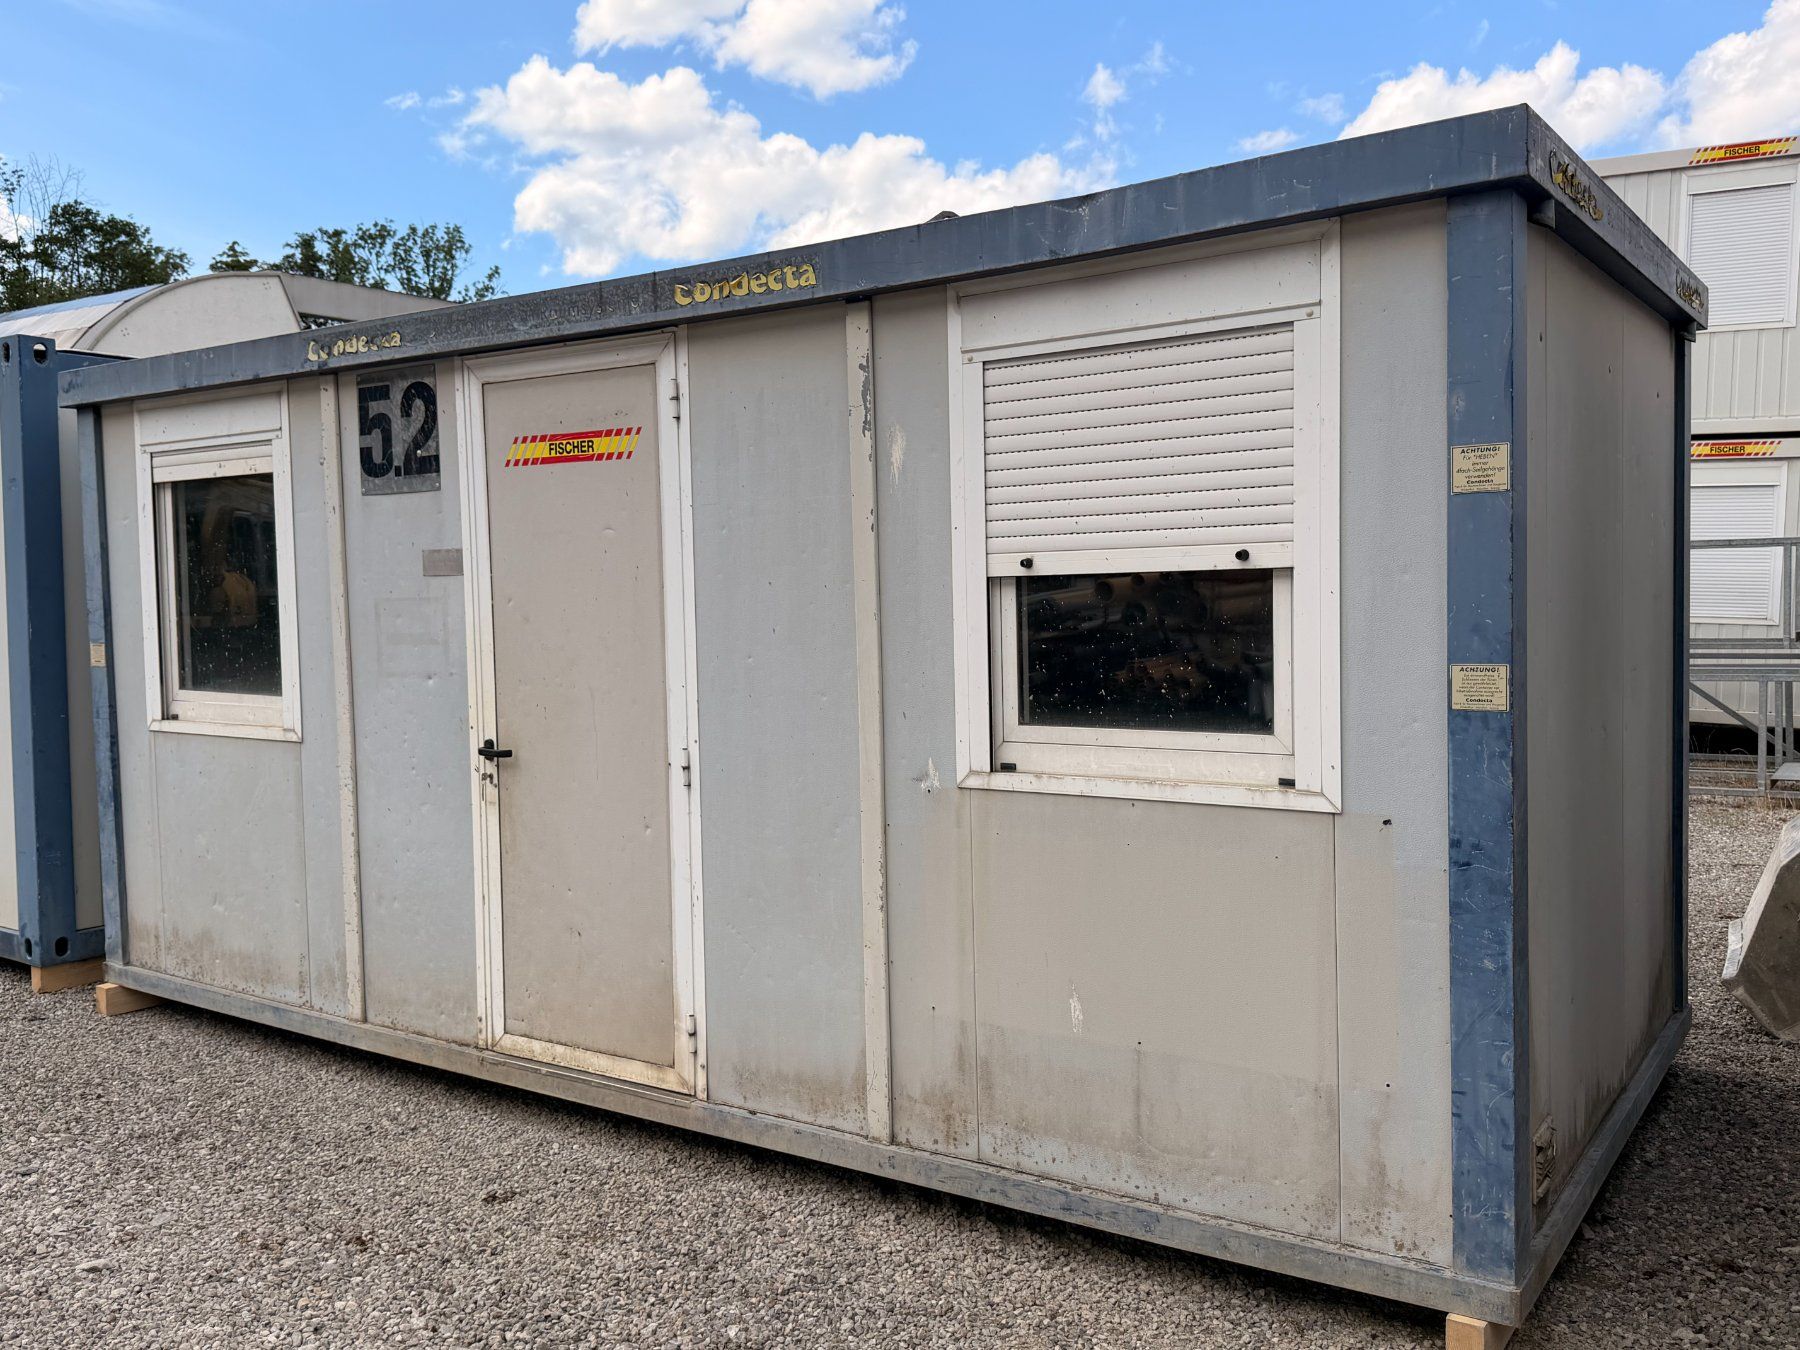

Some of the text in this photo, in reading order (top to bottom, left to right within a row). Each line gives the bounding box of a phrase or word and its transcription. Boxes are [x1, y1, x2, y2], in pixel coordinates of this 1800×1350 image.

[1724, 146, 1760, 156] FISCHER
[358, 381, 440, 478] 5.2
[548, 440, 595, 455] FISCHER
[1460, 446, 1500, 454] ACHTUNG!
